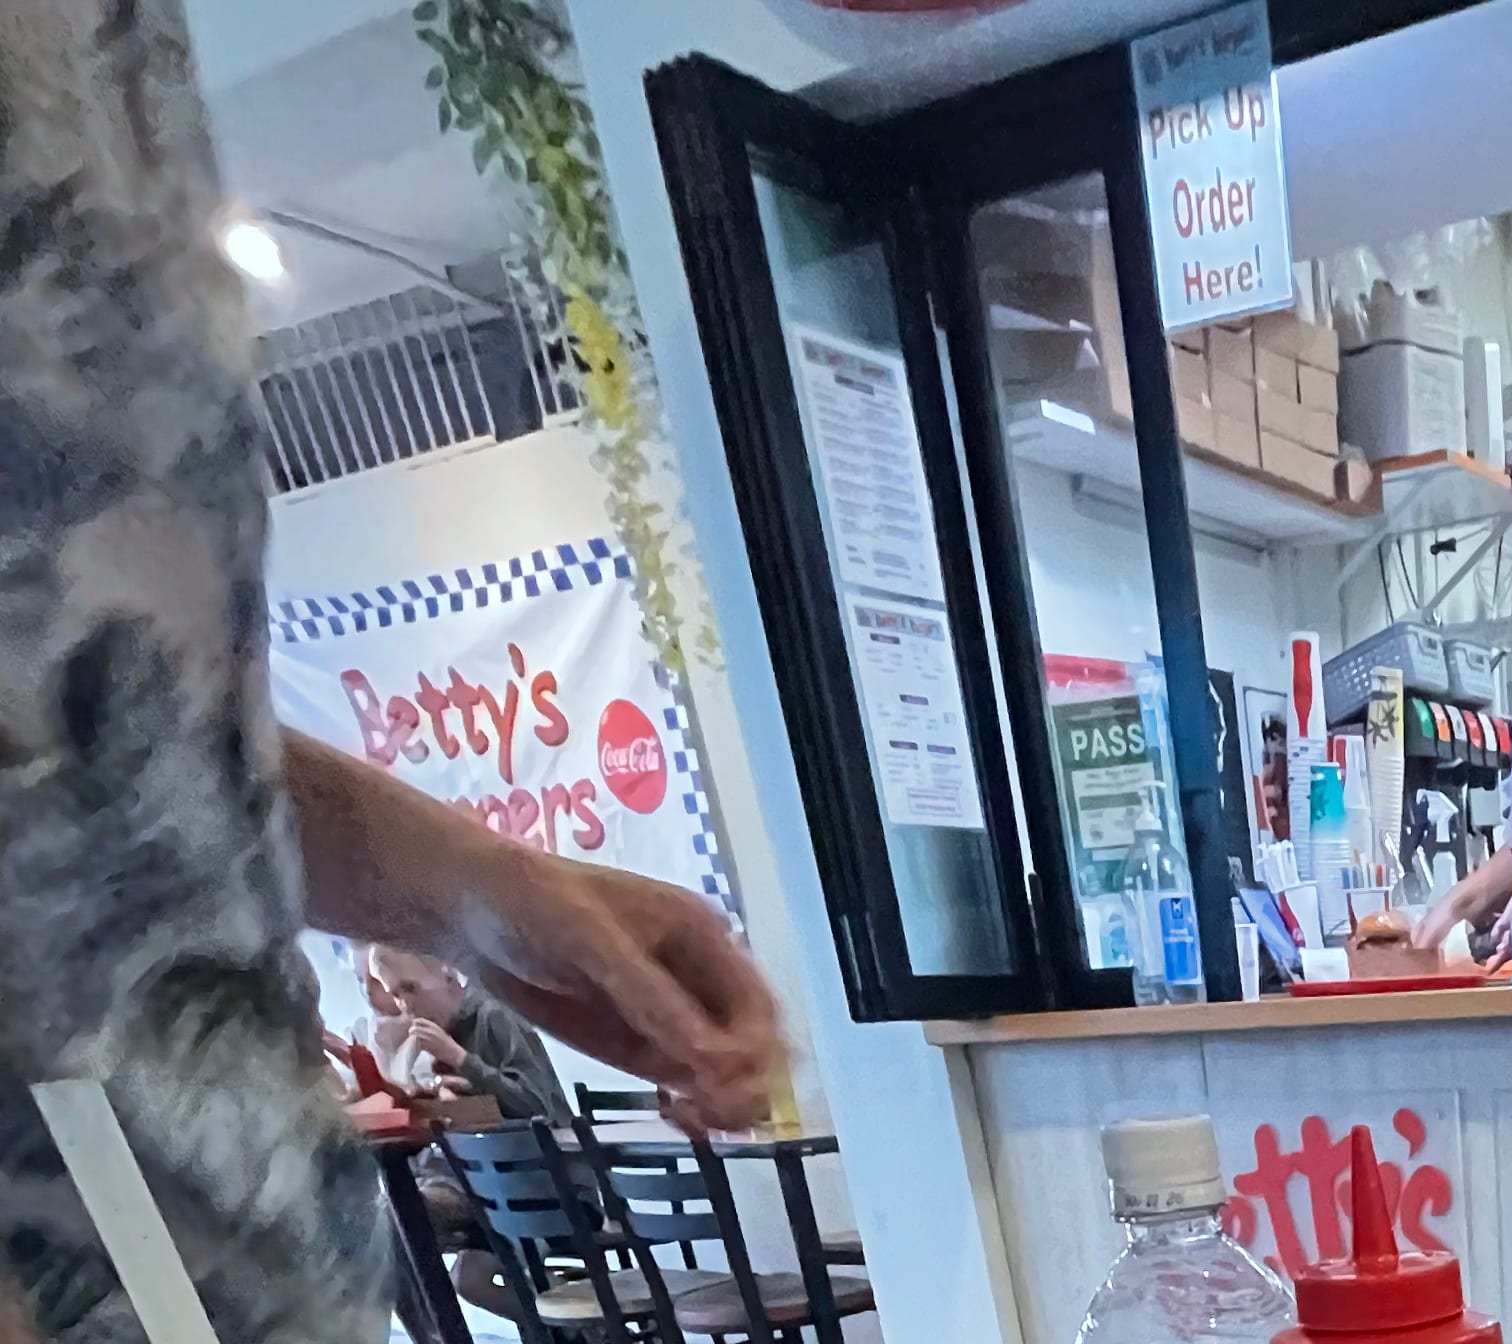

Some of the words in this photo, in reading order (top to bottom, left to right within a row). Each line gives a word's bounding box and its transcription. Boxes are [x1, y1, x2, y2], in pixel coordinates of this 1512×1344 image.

[1149, 97, 1213, 160] Pick
[1223, 85, 1265, 143] Up
[1173, 167, 1256, 239] Order
[1183, 244, 1263, 305] Here!
[341, 642, 569, 785] Betty's
[1070, 723, 1145, 761] PASS
